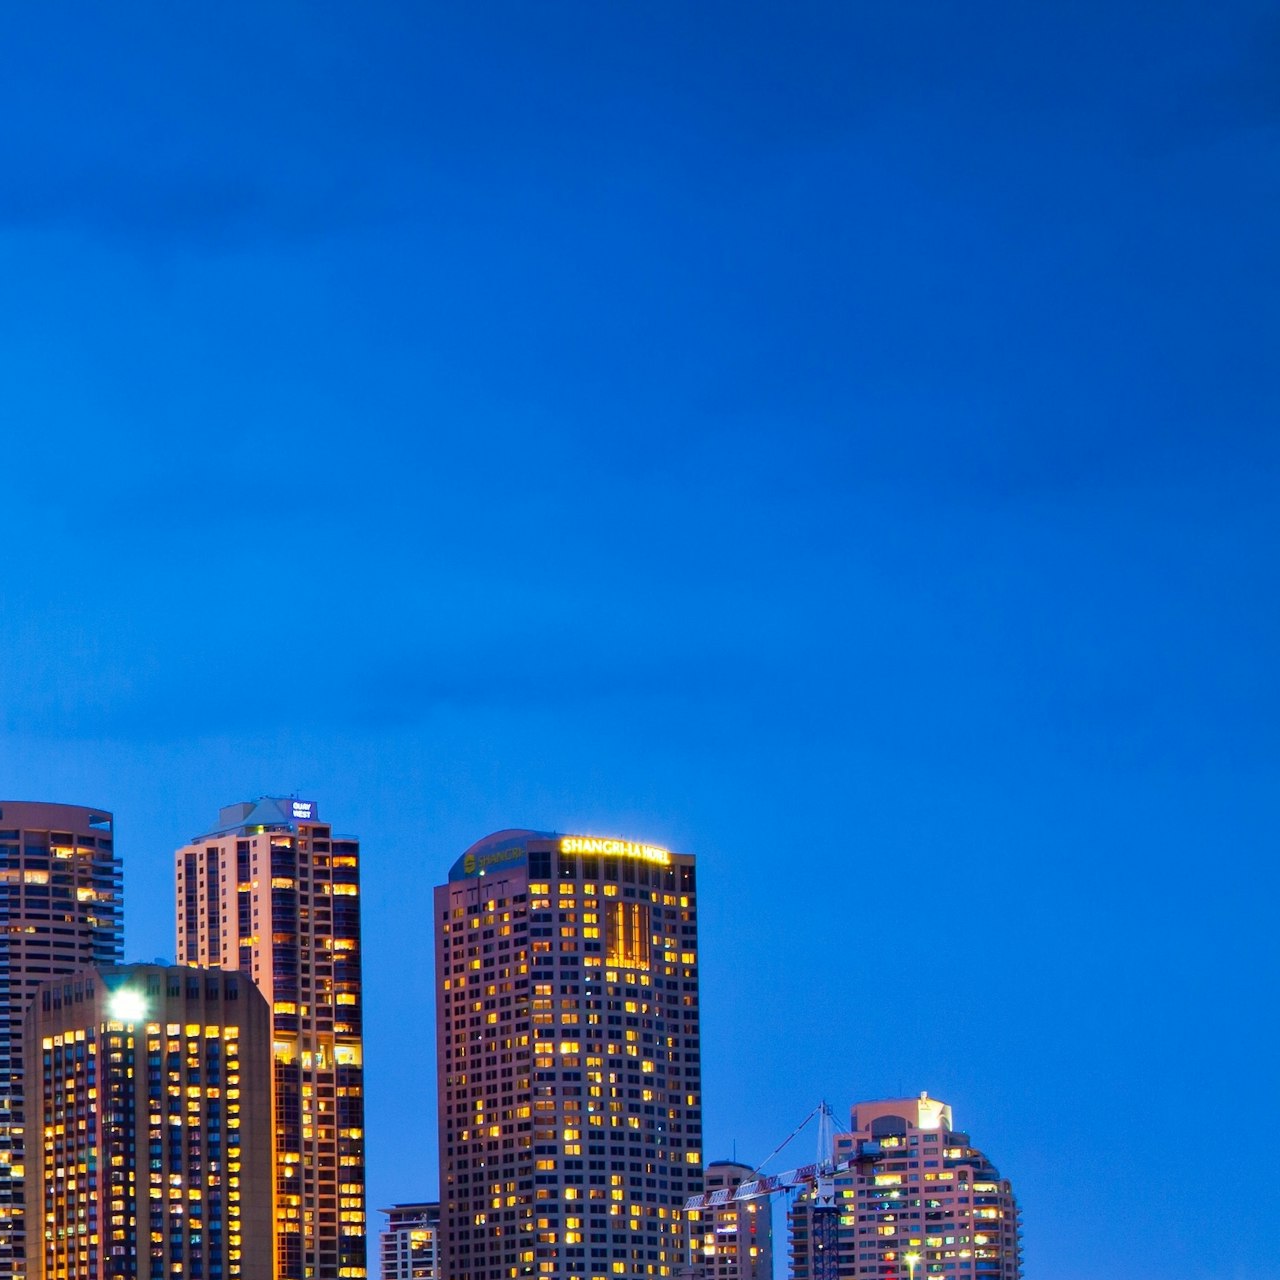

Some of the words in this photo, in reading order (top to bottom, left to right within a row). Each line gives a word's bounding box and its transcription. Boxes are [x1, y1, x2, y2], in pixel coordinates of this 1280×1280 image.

[293, 810, 311, 818] WEST
[561, 838, 642, 858] SHANGRI-LA
[643, 846, 671, 865] HOTEL
